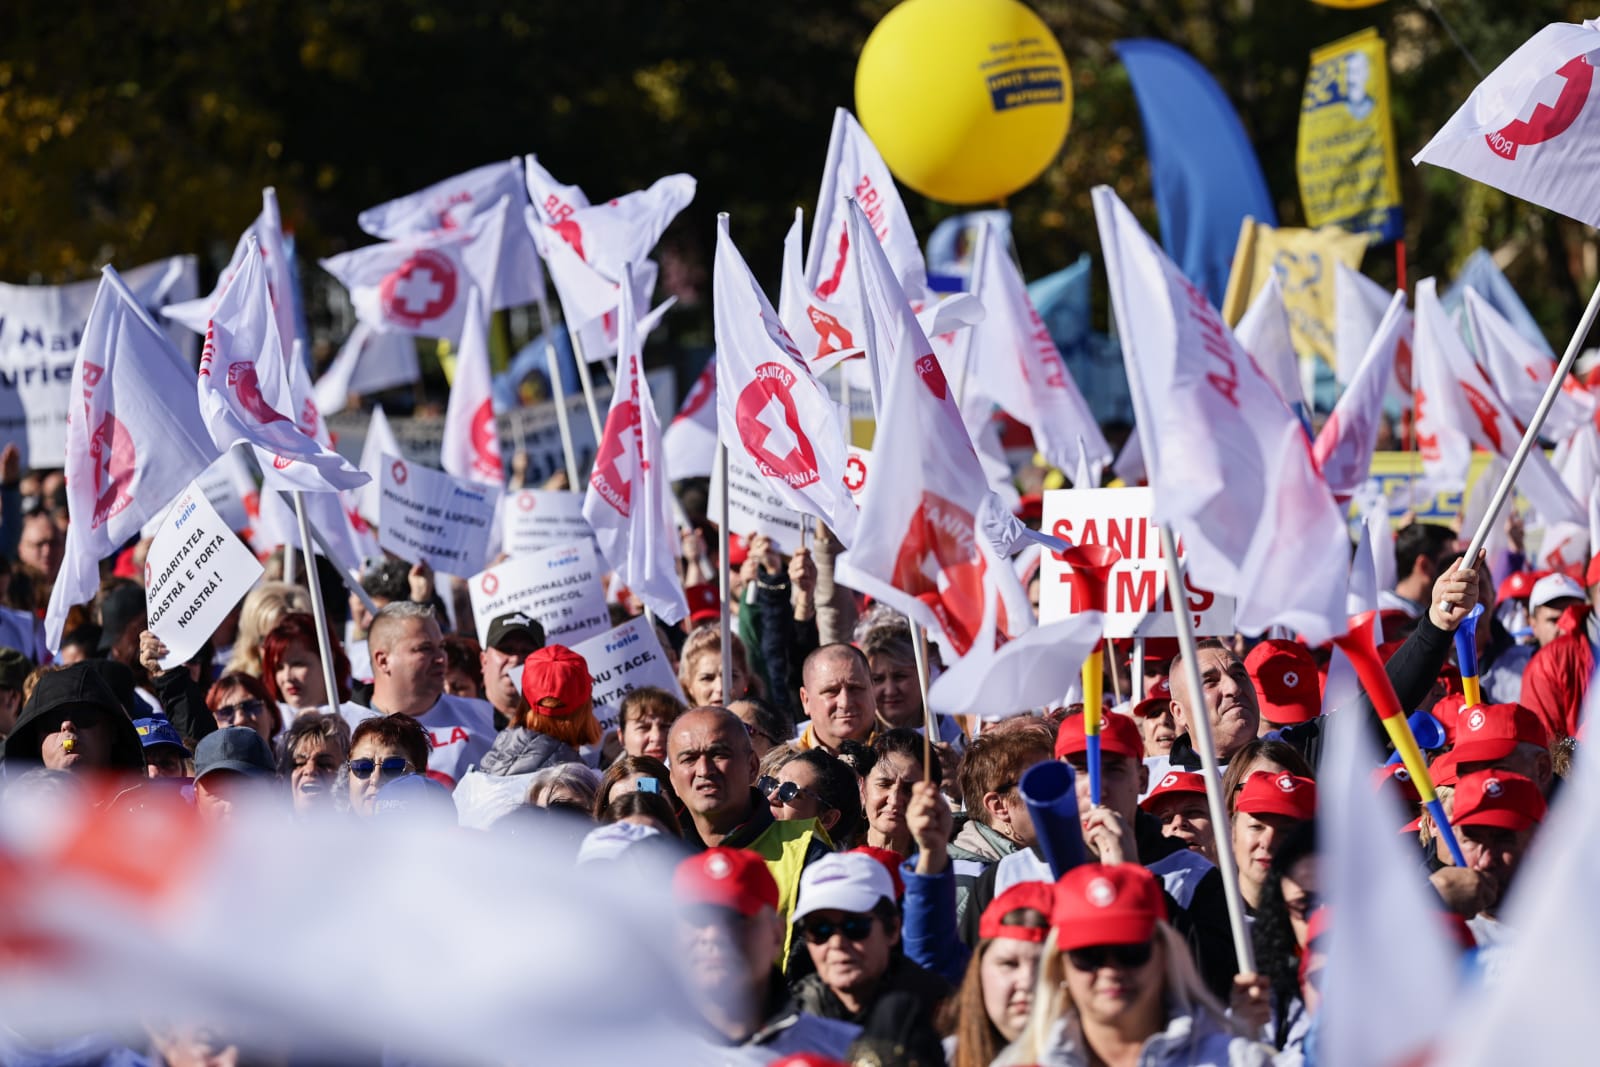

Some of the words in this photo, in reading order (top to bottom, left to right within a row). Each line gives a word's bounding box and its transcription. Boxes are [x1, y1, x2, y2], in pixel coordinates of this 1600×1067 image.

[757, 365, 793, 387] SANITAS
[148, 528, 205, 604] SOLIDARITATEA
[148, 579, 186, 629] NOASTRĂ
[185, 569, 195, 581] E
[177, 579, 218, 629] NOASTRĂ
[614, 650, 657, 676] TACE,
[593, 682, 634, 709] NITAS
